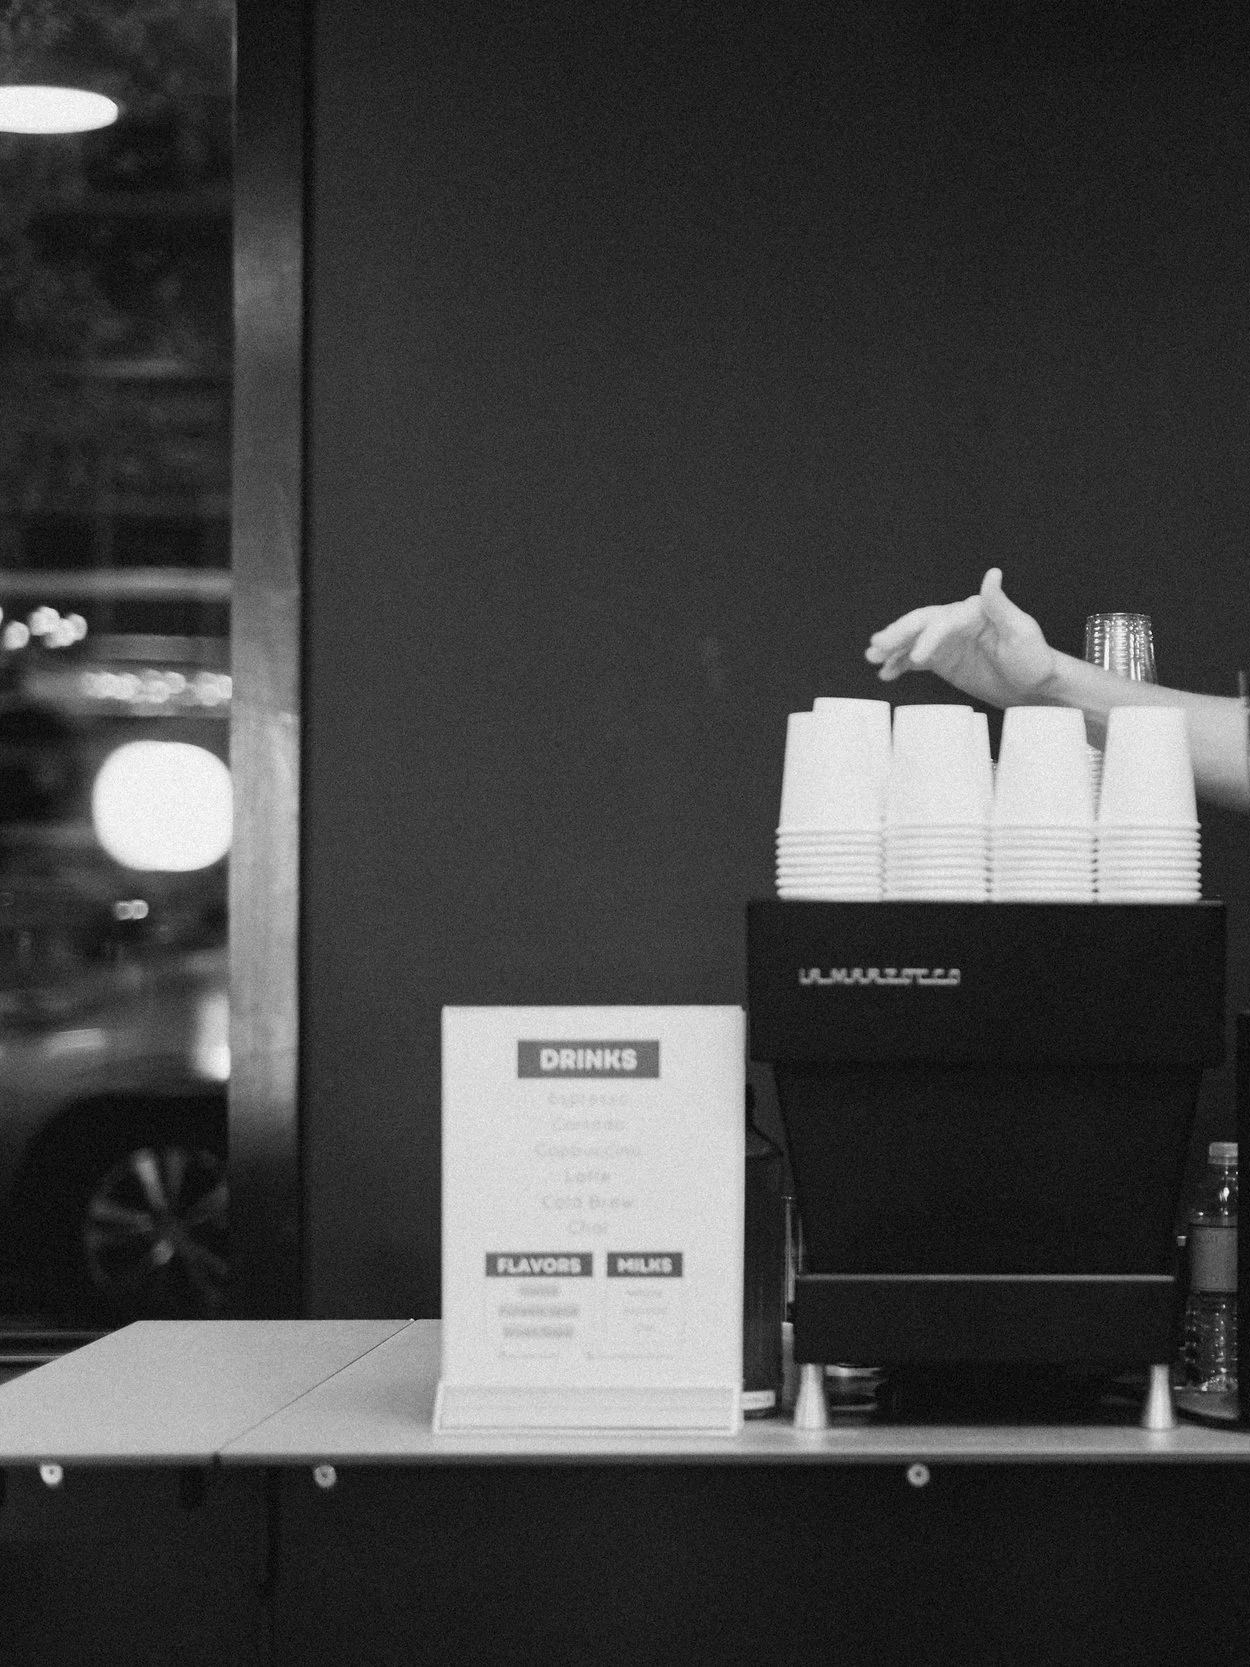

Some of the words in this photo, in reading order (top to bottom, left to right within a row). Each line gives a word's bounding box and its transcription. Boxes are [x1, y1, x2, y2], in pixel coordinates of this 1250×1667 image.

[539, 1047, 638, 1071] DRINKS
[541, 1194, 582, 1210] Cold
[588, 1194, 635, 1210] Brew
[496, 1257, 581, 1273] FLAVORS
[616, 1257, 672, 1273] MILKS
